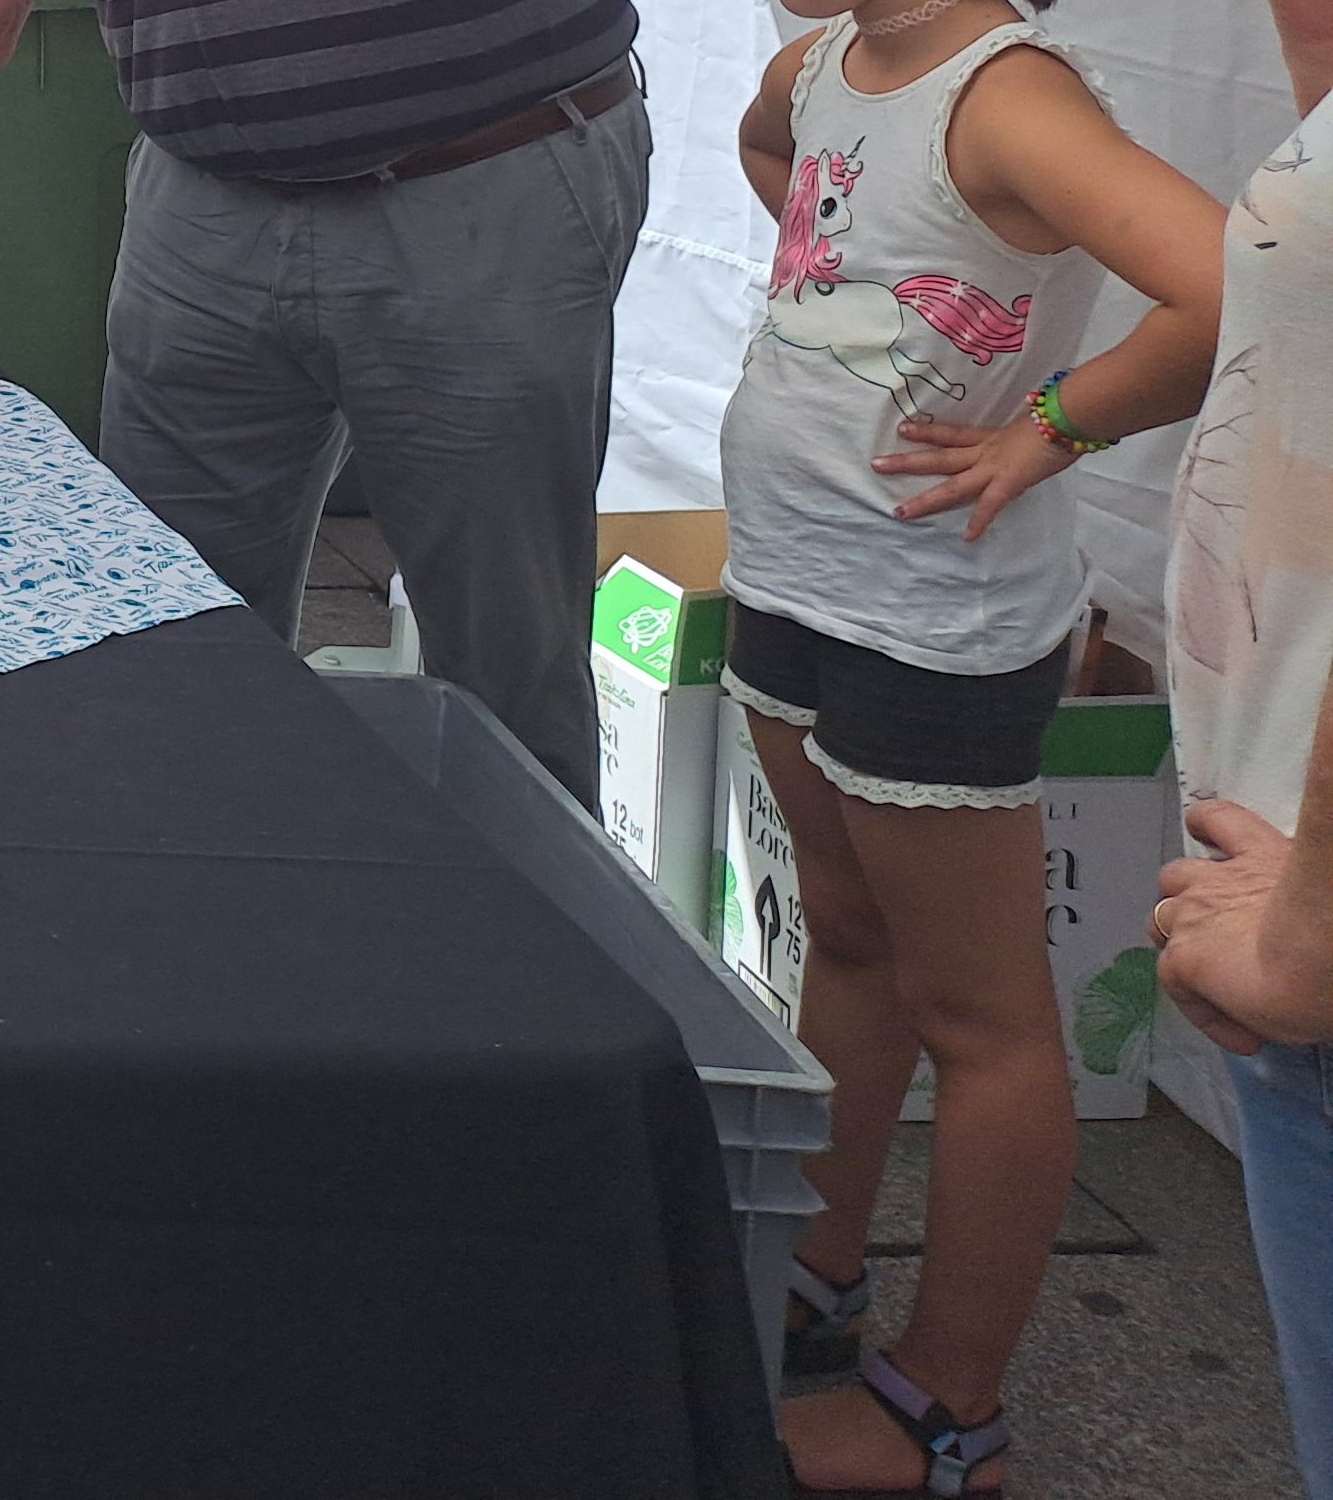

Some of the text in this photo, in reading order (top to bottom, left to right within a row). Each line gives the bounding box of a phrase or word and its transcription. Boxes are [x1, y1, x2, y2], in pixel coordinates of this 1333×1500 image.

[612, 799, 644, 845] 12 bot
[749, 773, 788, 832] Bas
[788, 895, 802, 930] 12
[786, 929, 801, 965] 75
